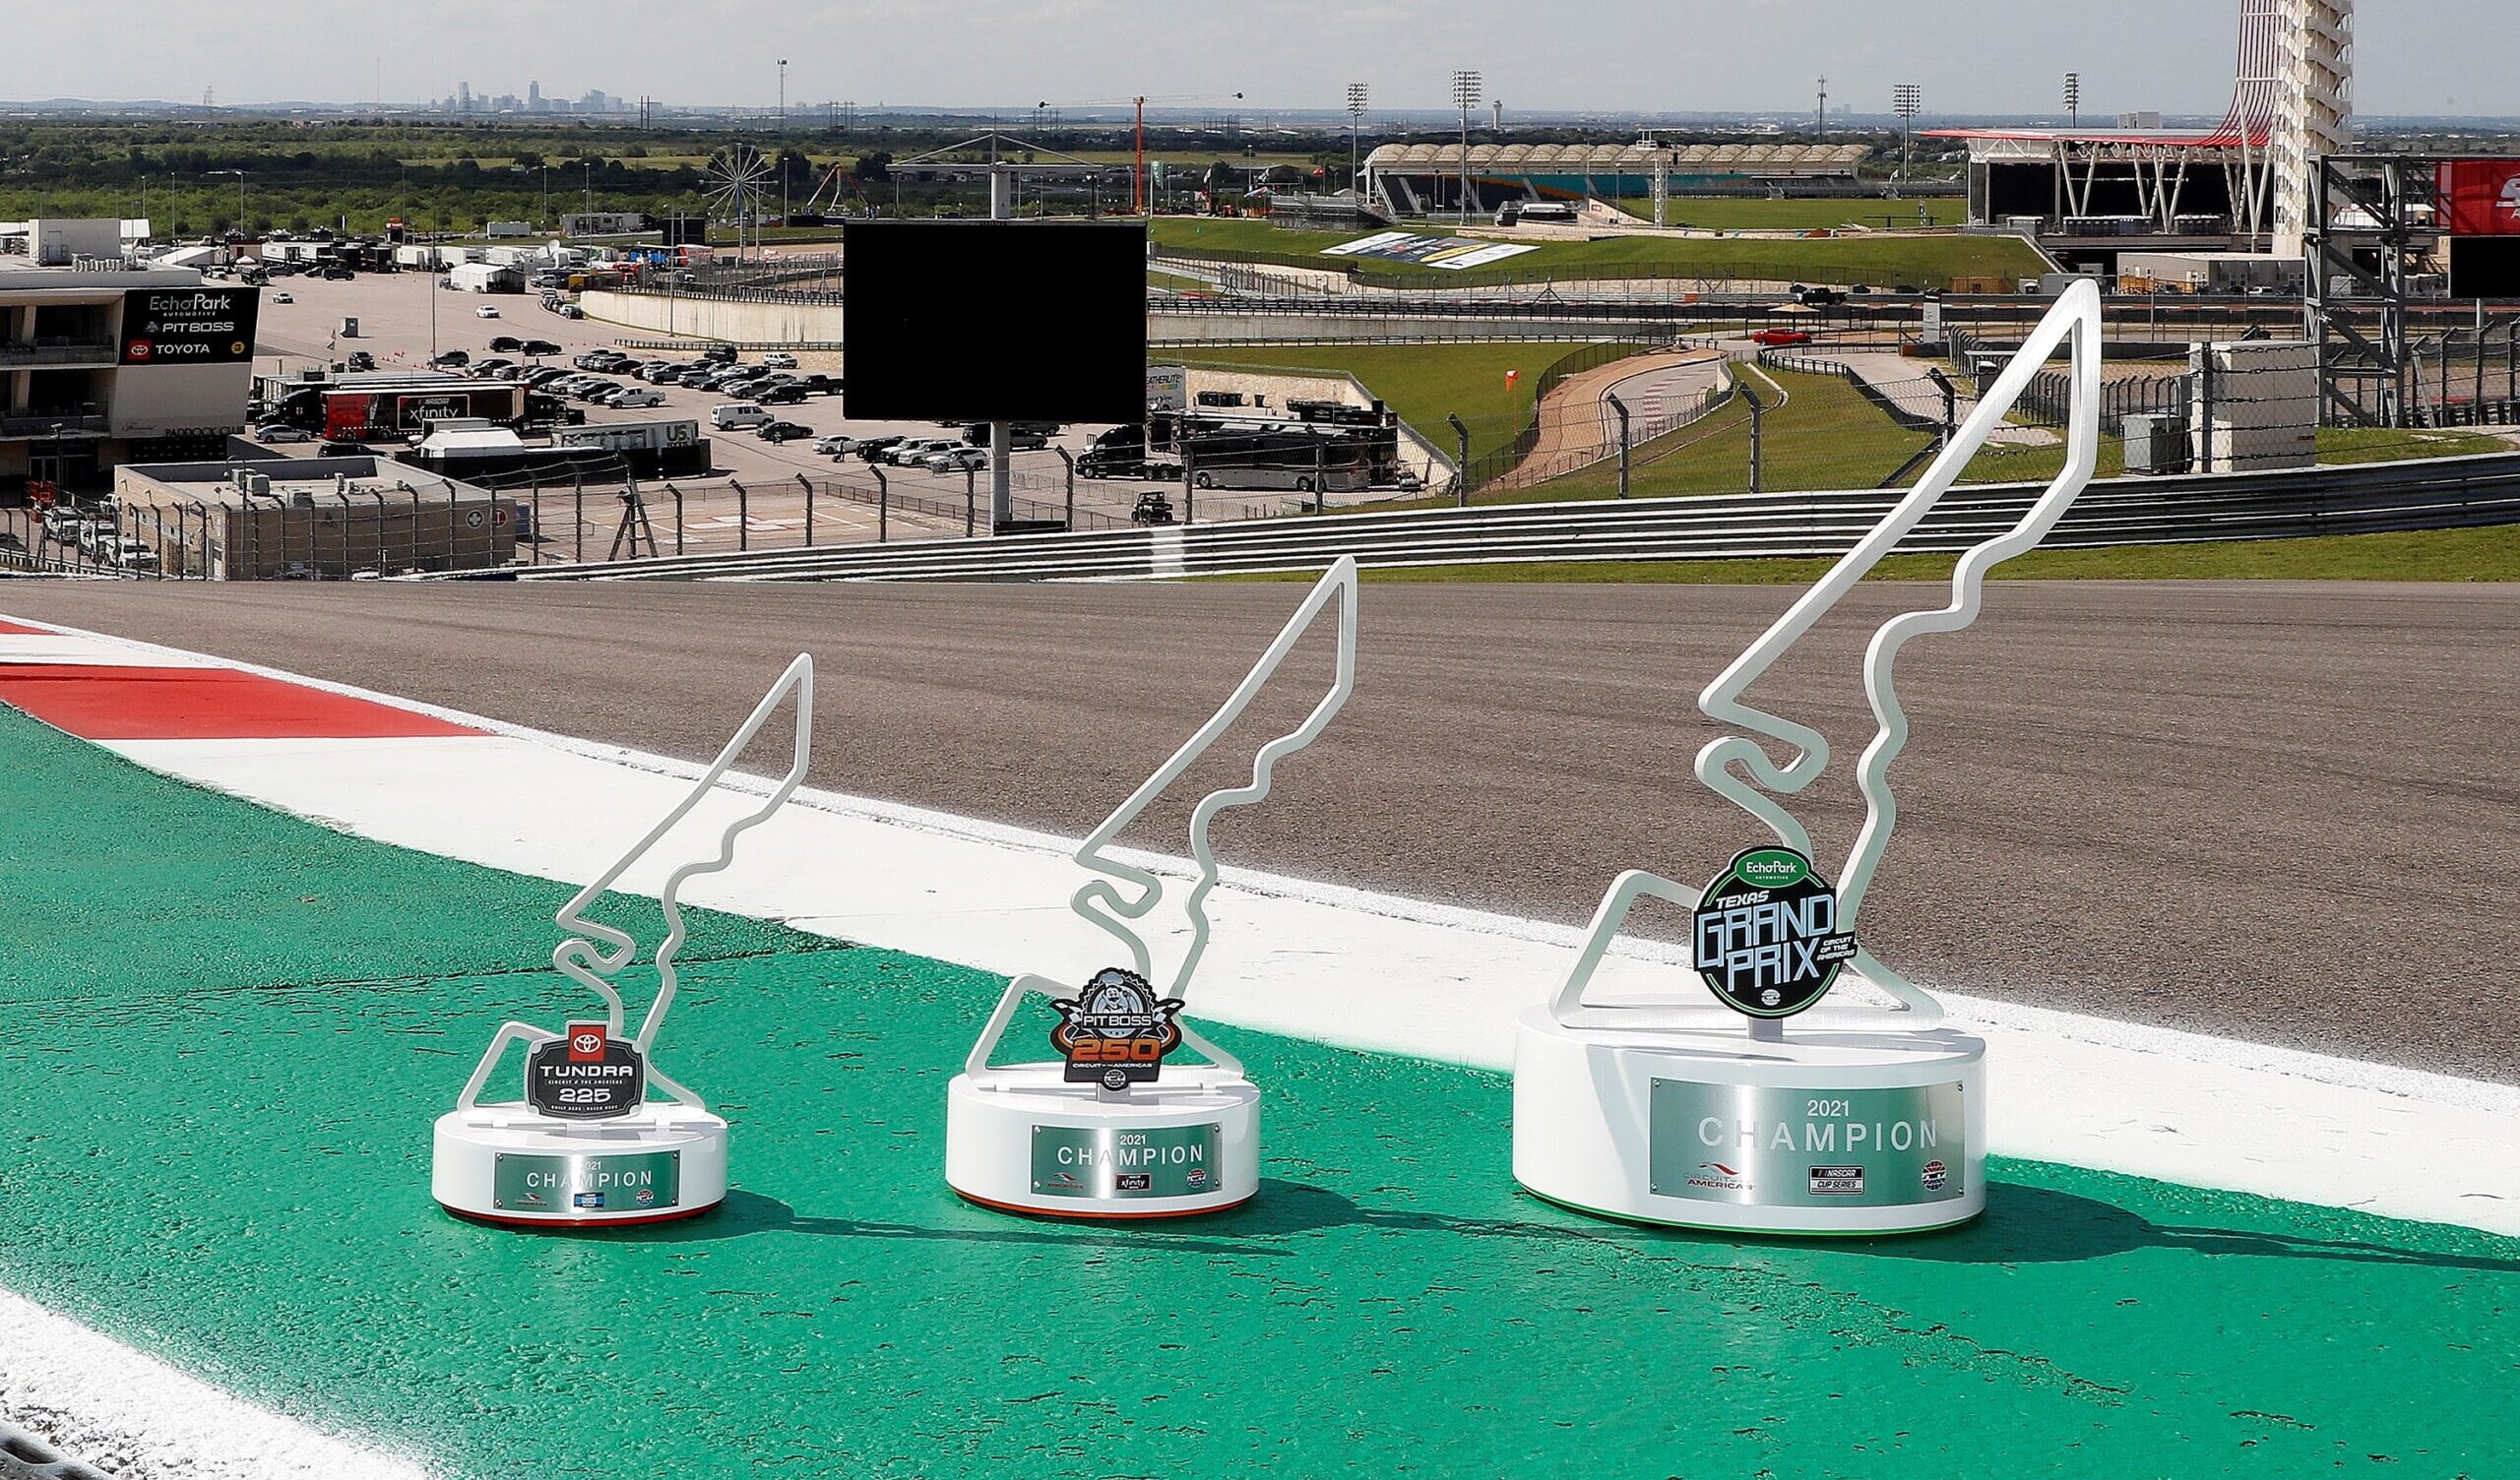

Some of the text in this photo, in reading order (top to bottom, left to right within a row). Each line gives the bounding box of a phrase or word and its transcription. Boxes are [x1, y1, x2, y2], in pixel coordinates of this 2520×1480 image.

[150, 294, 230, 311] EchoPark
[156, 344, 210, 354] TOYOTA
[410, 405, 459, 423] xfinity
[1746, 860, 1796, 873] EchoPark
[1716, 890, 1769, 909] TEXAS
[1697, 894, 1835, 969] GRAND
[1823, 936, 1853, 946] CIRCUIT
[1816, 950, 1856, 960] AMERICAS
[1726, 937, 1820, 993] PRIX
[1072, 1039, 1161, 1061] 250
[539, 1066, 633, 1077] TUNDRA
[558, 1087, 611, 1103] 225
[1806, 1099, 1850, 1117] 2021
[1120, 1134, 1147, 1145] 2021
[1698, 1116, 1937, 1152] CHAMPION
[1057, 1144, 1203, 1166] CHAMPION
[580, 1160, 601, 1170] 021
[526, 1170, 652, 1189] CHAMPION
[1120, 1178, 1145, 1189] xfinity
